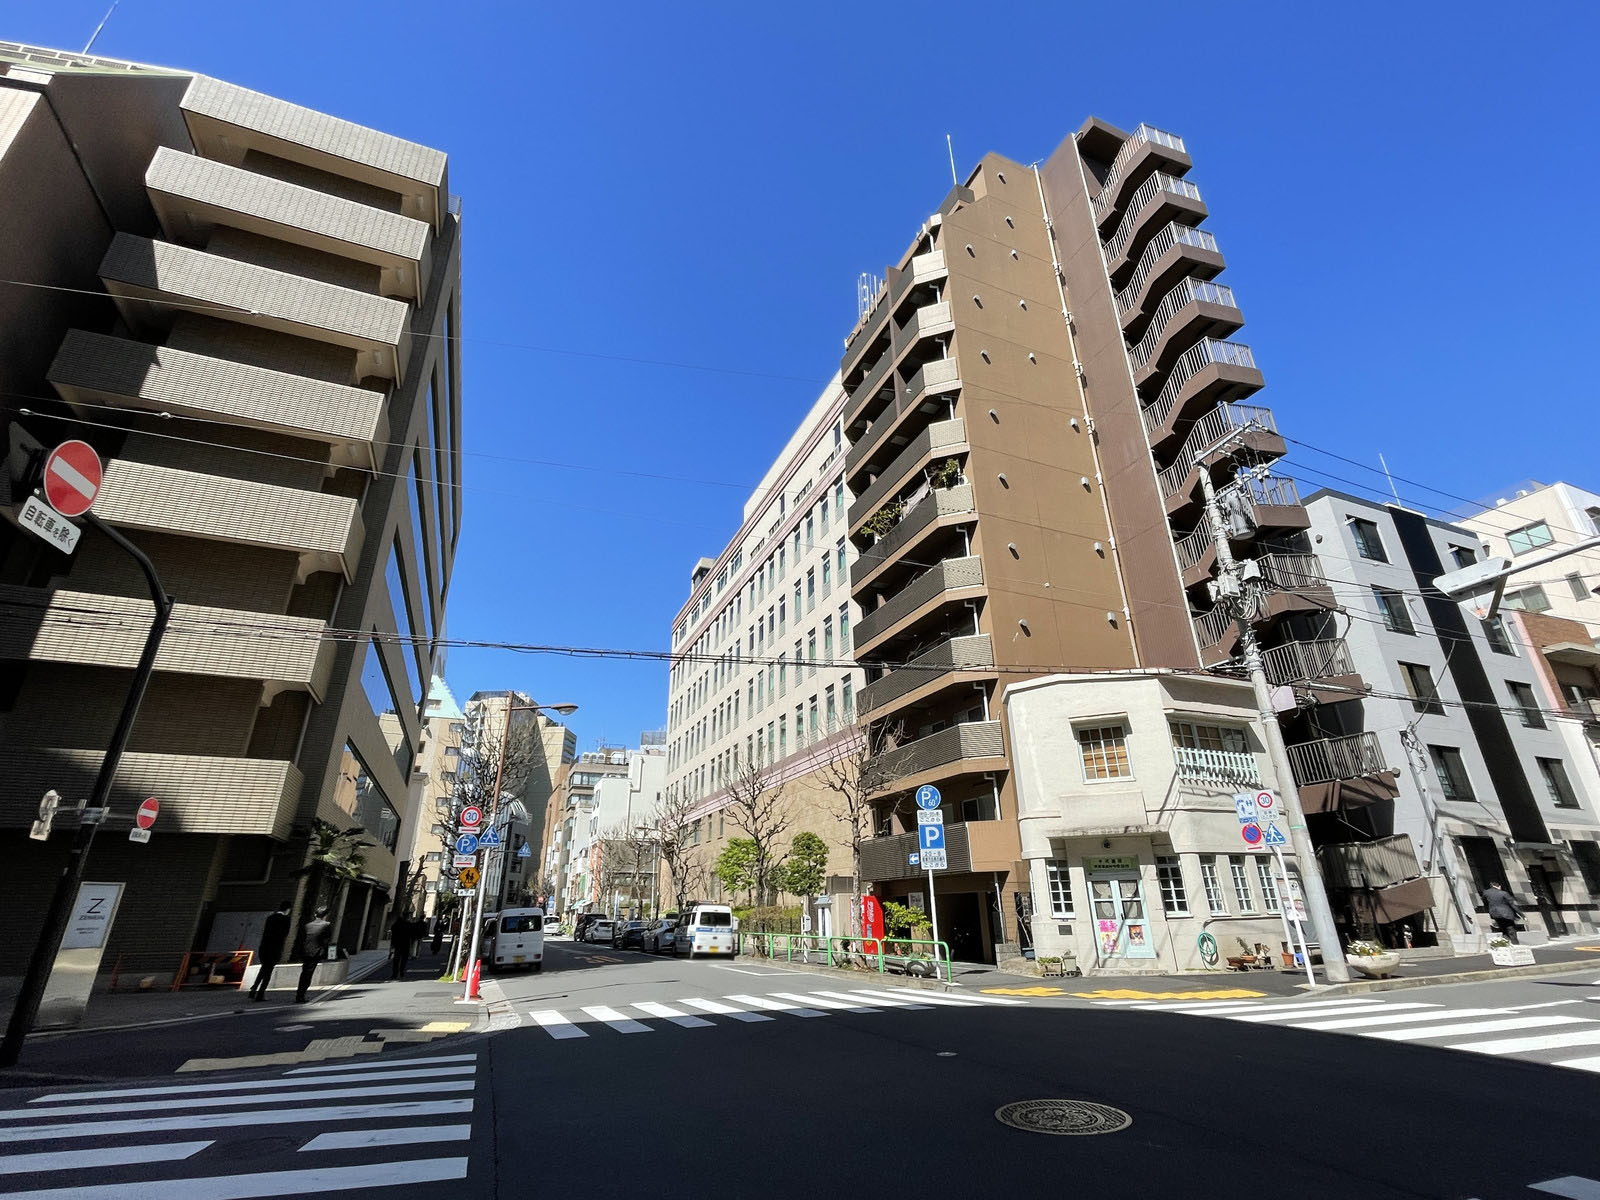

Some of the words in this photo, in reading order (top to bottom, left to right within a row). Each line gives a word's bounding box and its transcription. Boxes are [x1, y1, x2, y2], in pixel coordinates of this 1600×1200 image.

[24, 504, 74, 547] 自転車を除く
[921, 791, 931, 806] P
[1260, 796, 1270, 805] 30
[465, 812, 478, 821] 30
[925, 826, 940, 848] P
[461, 838, 470, 852] P
[86, 898, 105, 914] Z
